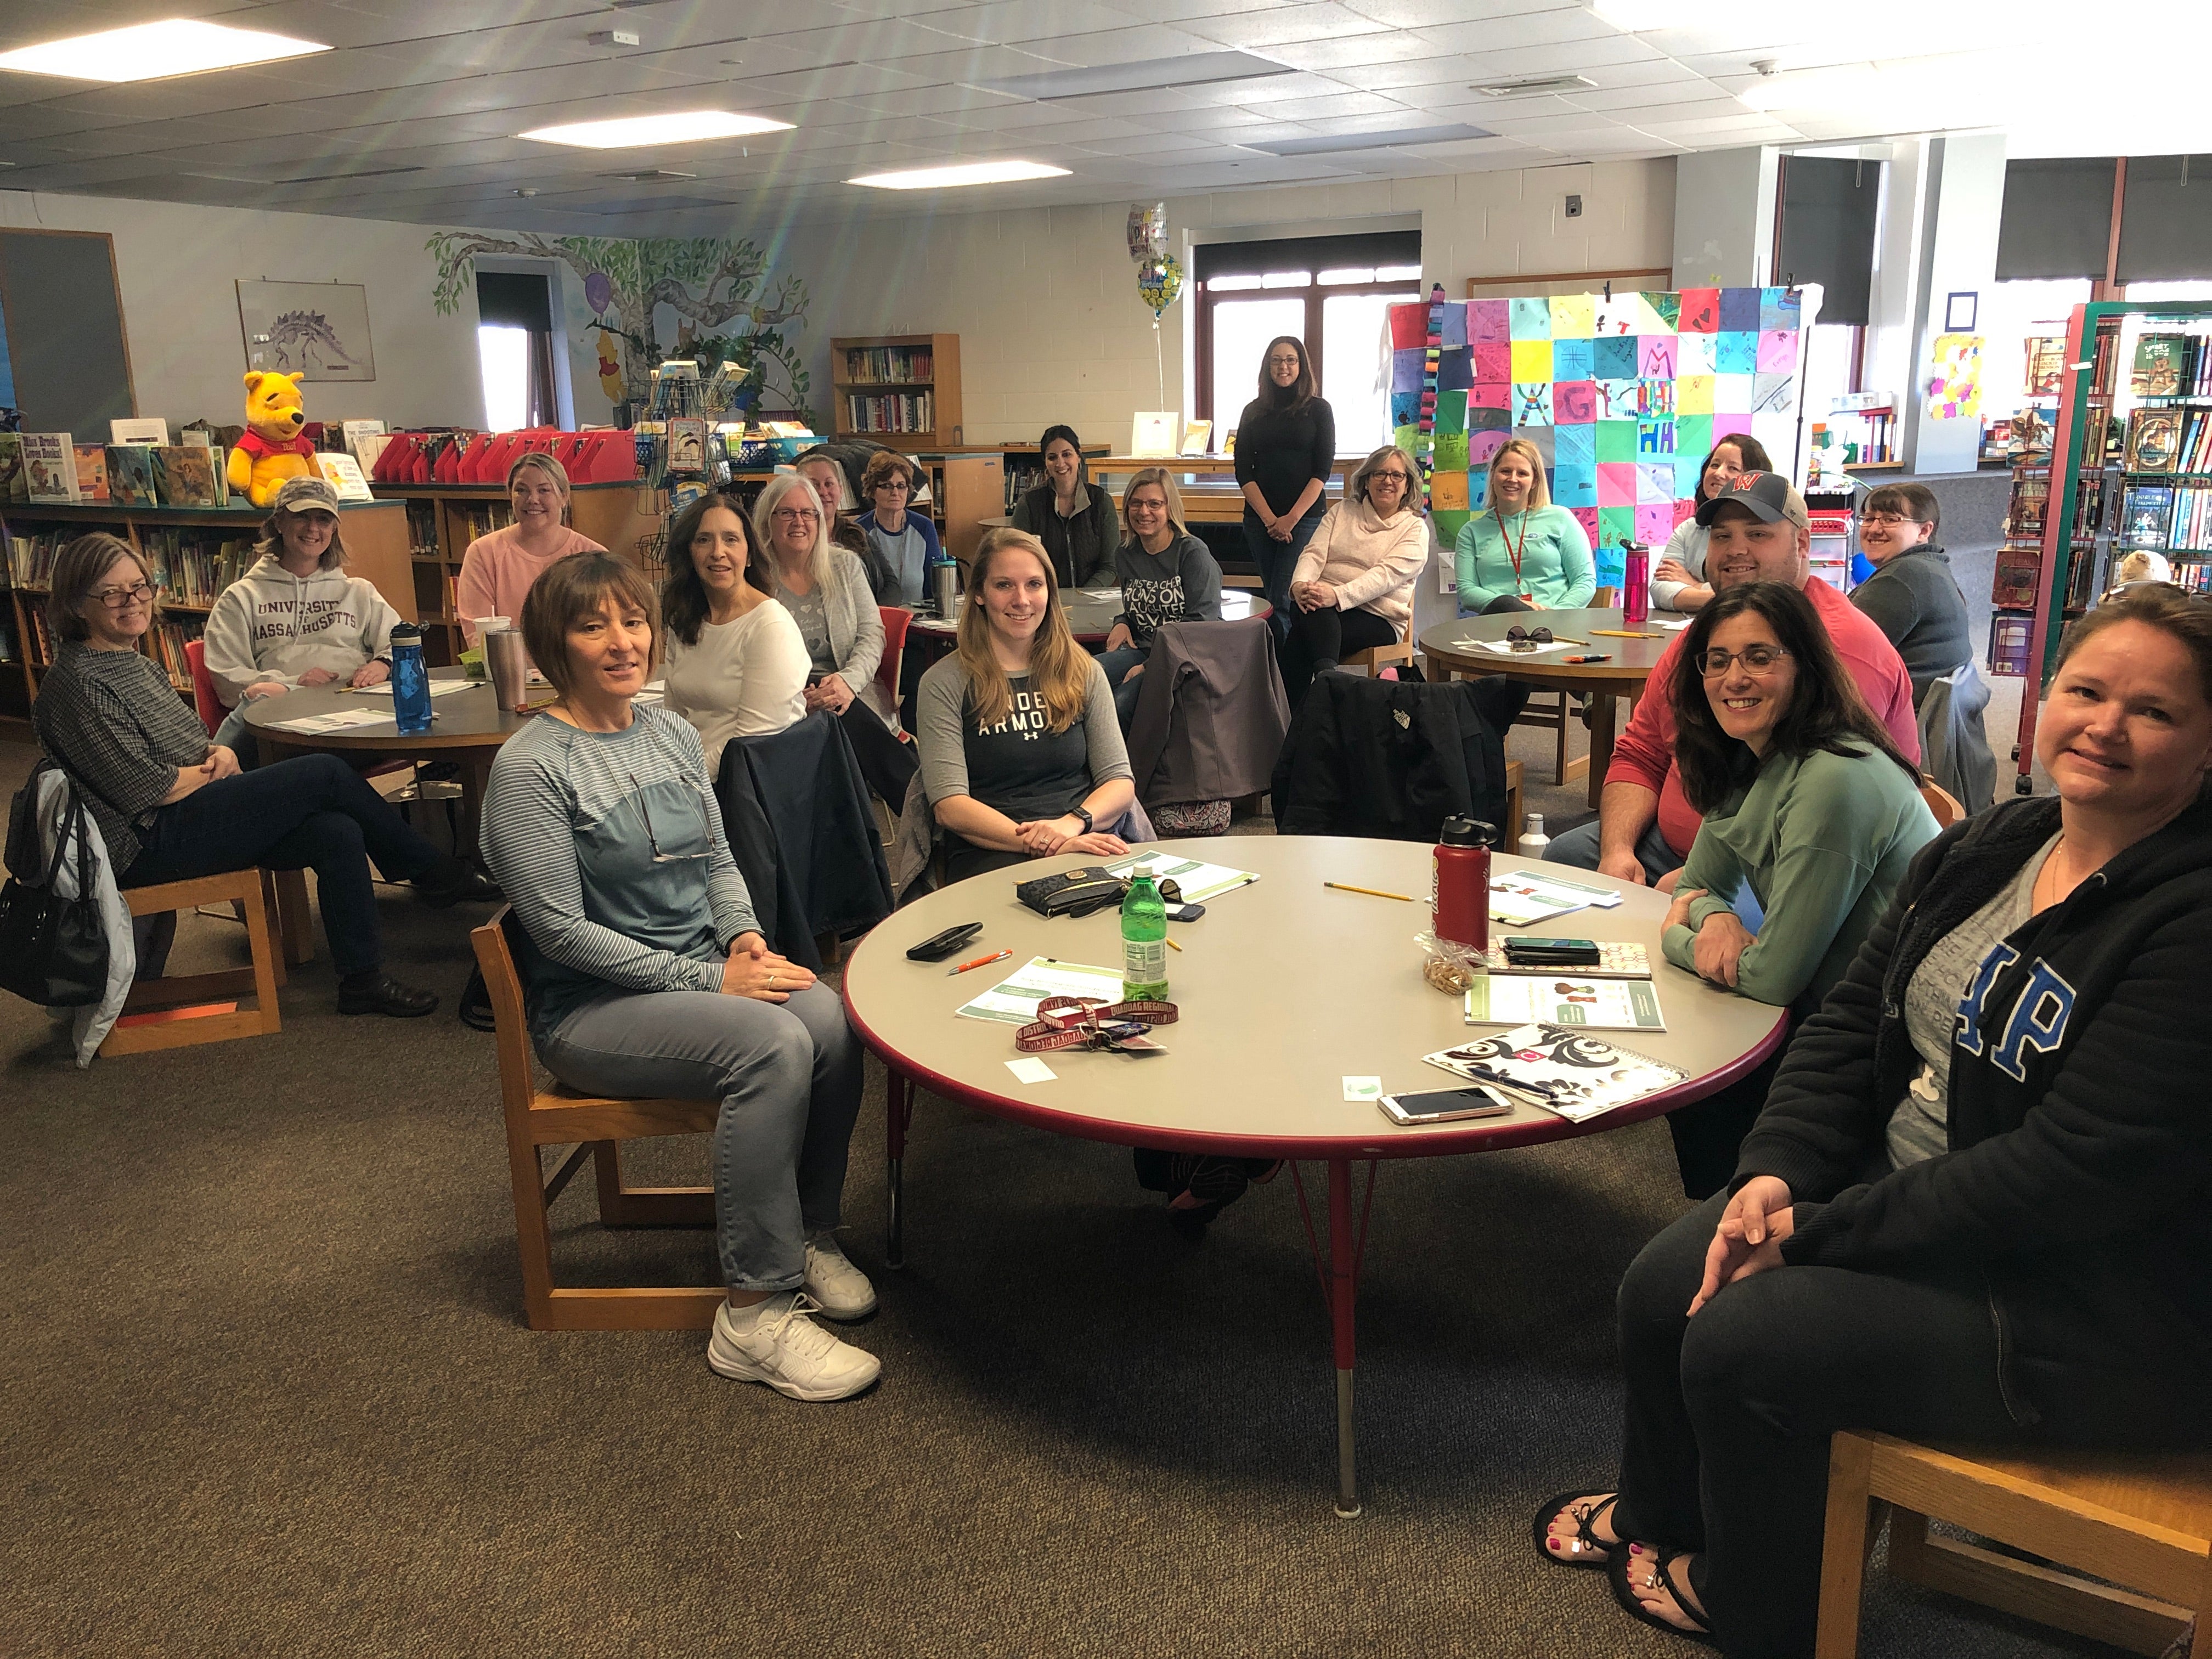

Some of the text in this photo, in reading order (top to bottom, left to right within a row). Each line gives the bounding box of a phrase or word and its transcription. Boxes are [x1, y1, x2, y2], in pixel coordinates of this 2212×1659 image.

[1564, 386, 1589, 420] G
[1123, 585, 1185, 604] RUNS ON
